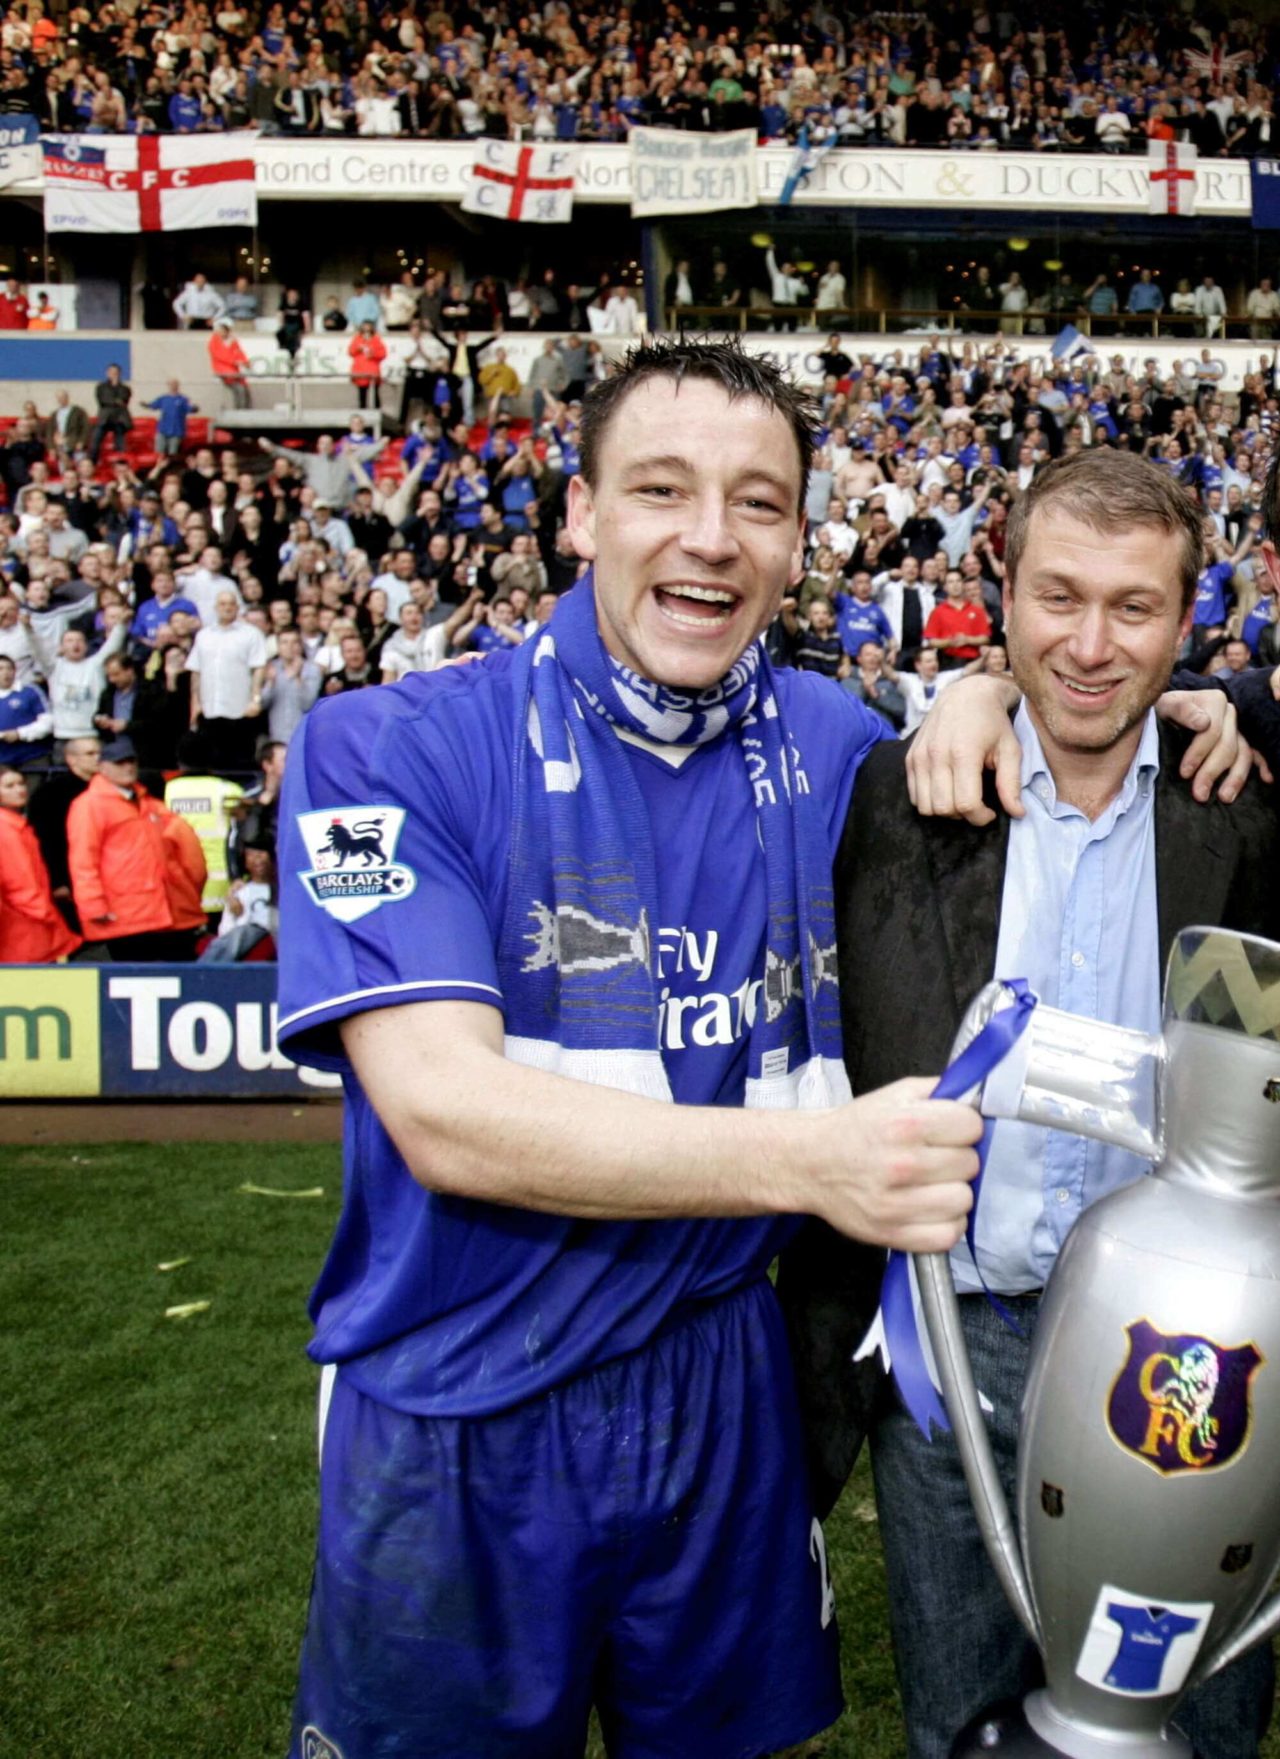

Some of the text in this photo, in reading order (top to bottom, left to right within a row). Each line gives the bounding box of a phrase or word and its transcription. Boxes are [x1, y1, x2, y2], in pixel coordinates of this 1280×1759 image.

[342, 156, 450, 184] Centre
[936, 160, 977, 197] &
[657, 926, 718, 982] Fly
[108, 976, 345, 1088] Tou
